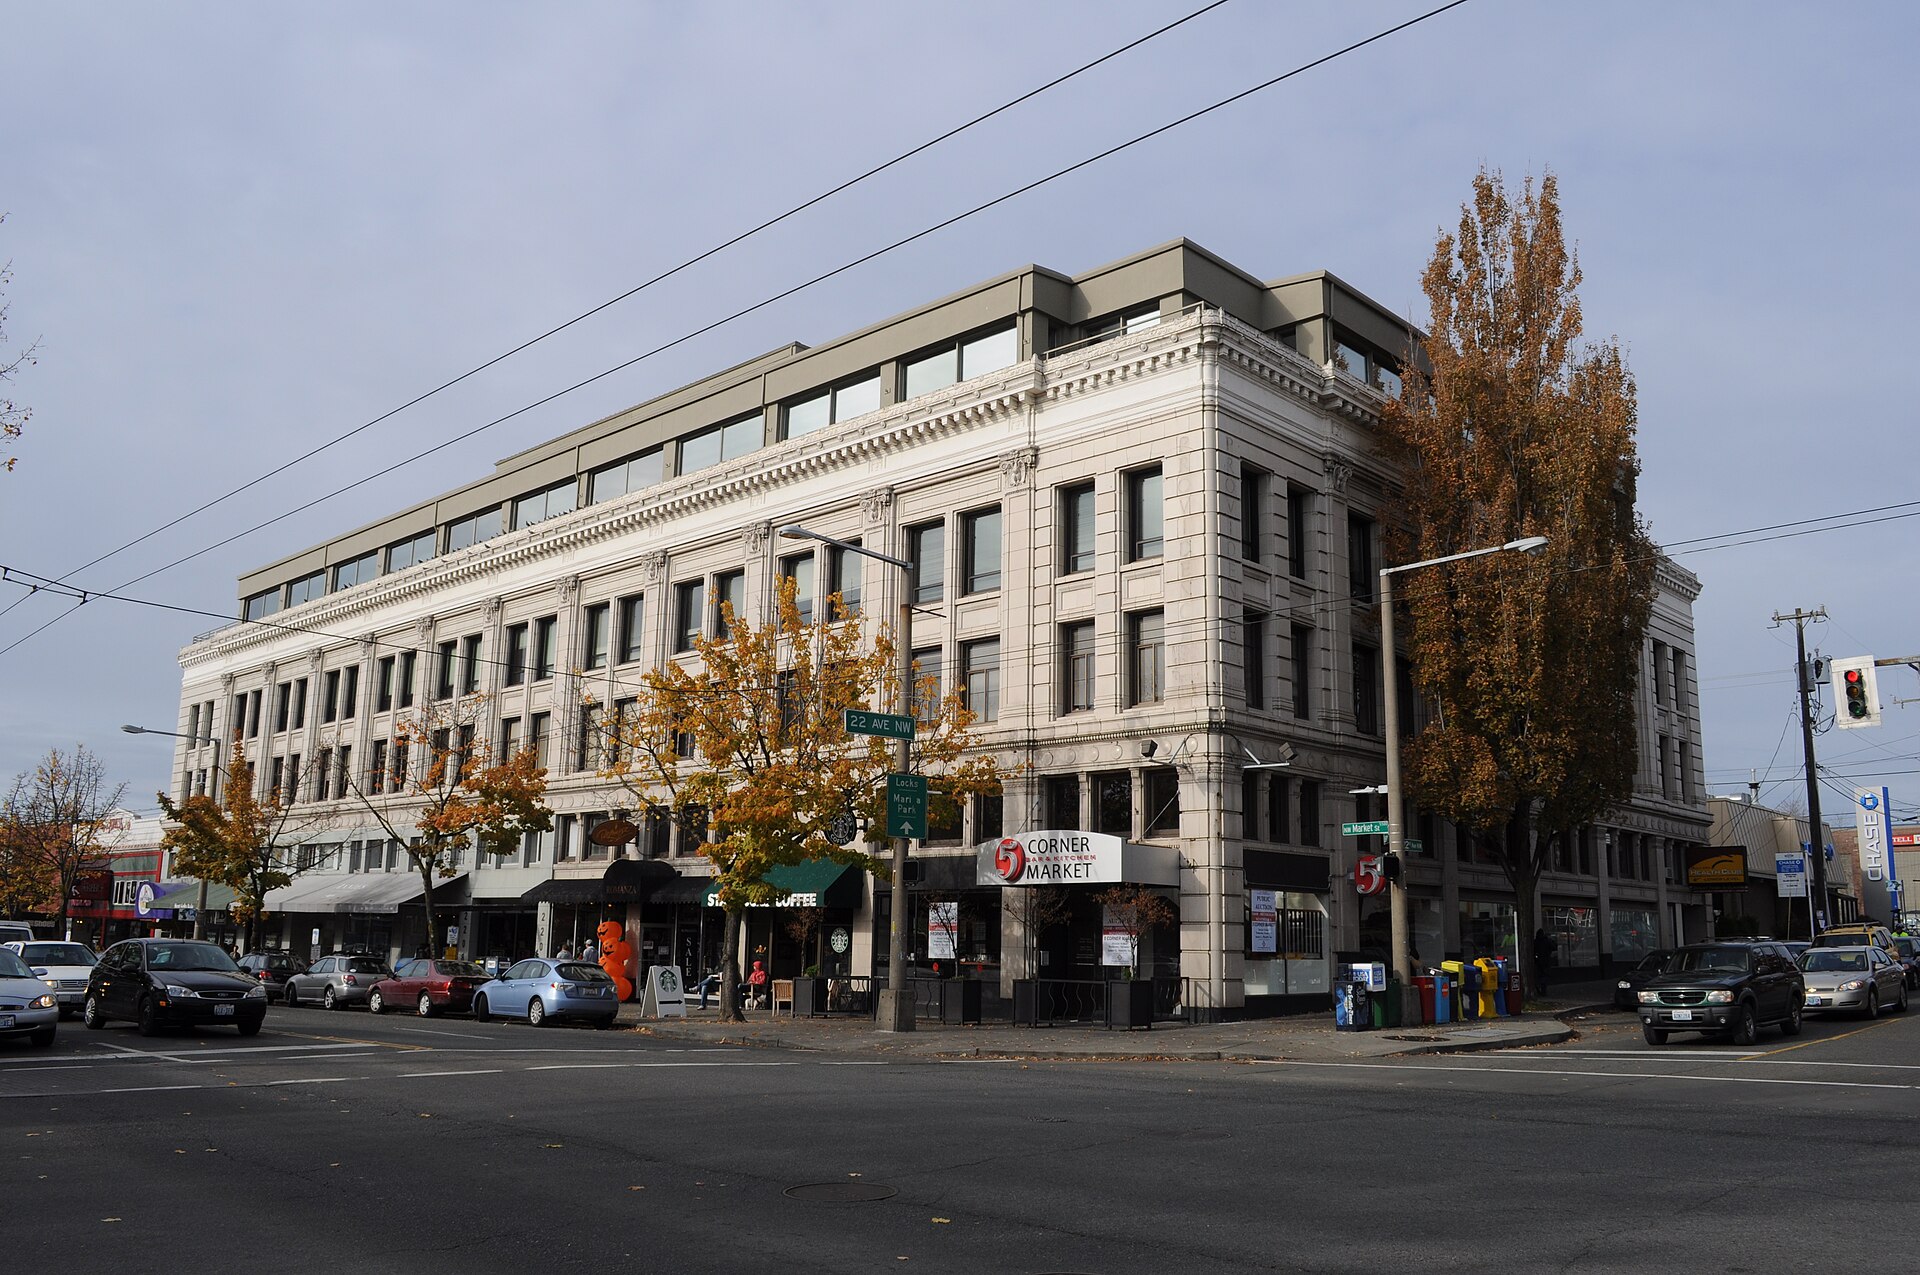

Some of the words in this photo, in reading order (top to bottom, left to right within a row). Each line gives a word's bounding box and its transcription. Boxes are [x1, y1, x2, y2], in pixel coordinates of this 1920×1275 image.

[850, 715, 866, 728] 22
[872, 718, 890, 730] AVE
[895, 721, 911, 733] NW
[895, 777, 919, 788] Locks
[897, 804, 917, 814] Park
[1352, 823, 1373, 833] Market
[1863, 813, 1883, 881] CHASE
[998, 840, 1018, 880] 5
[1028, 837, 1090, 854] CORNER
[1025, 855, 1043, 863] BAR
[1053, 854, 1097, 862] KITCHEN
[1026, 862, 1092, 880] MARKET
[1356, 856, 1383, 894] 5
